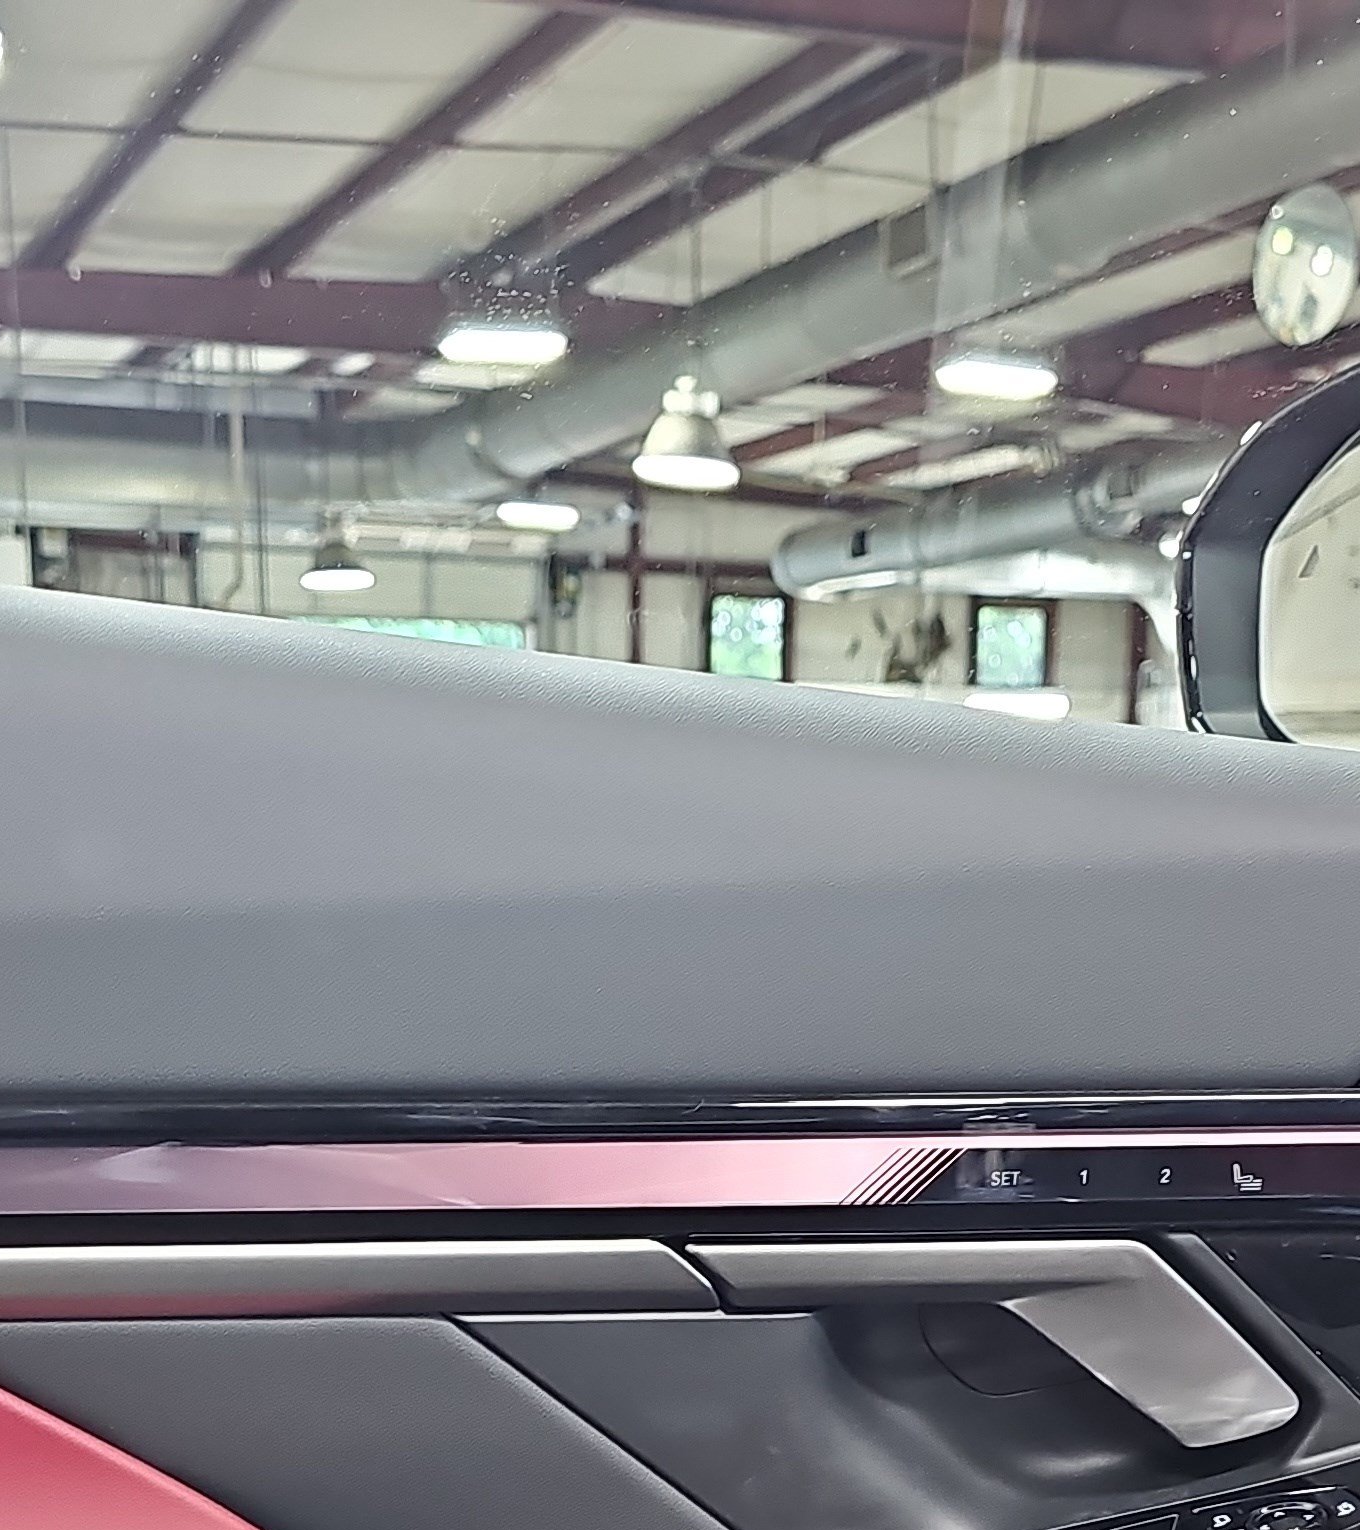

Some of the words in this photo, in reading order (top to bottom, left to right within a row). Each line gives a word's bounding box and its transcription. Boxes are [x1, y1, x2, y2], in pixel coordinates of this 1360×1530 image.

[990, 1170, 1021, 1187] SET
[1079, 1169, 1088, 1185] 1
[1159, 1168, 1172, 1184] 2
